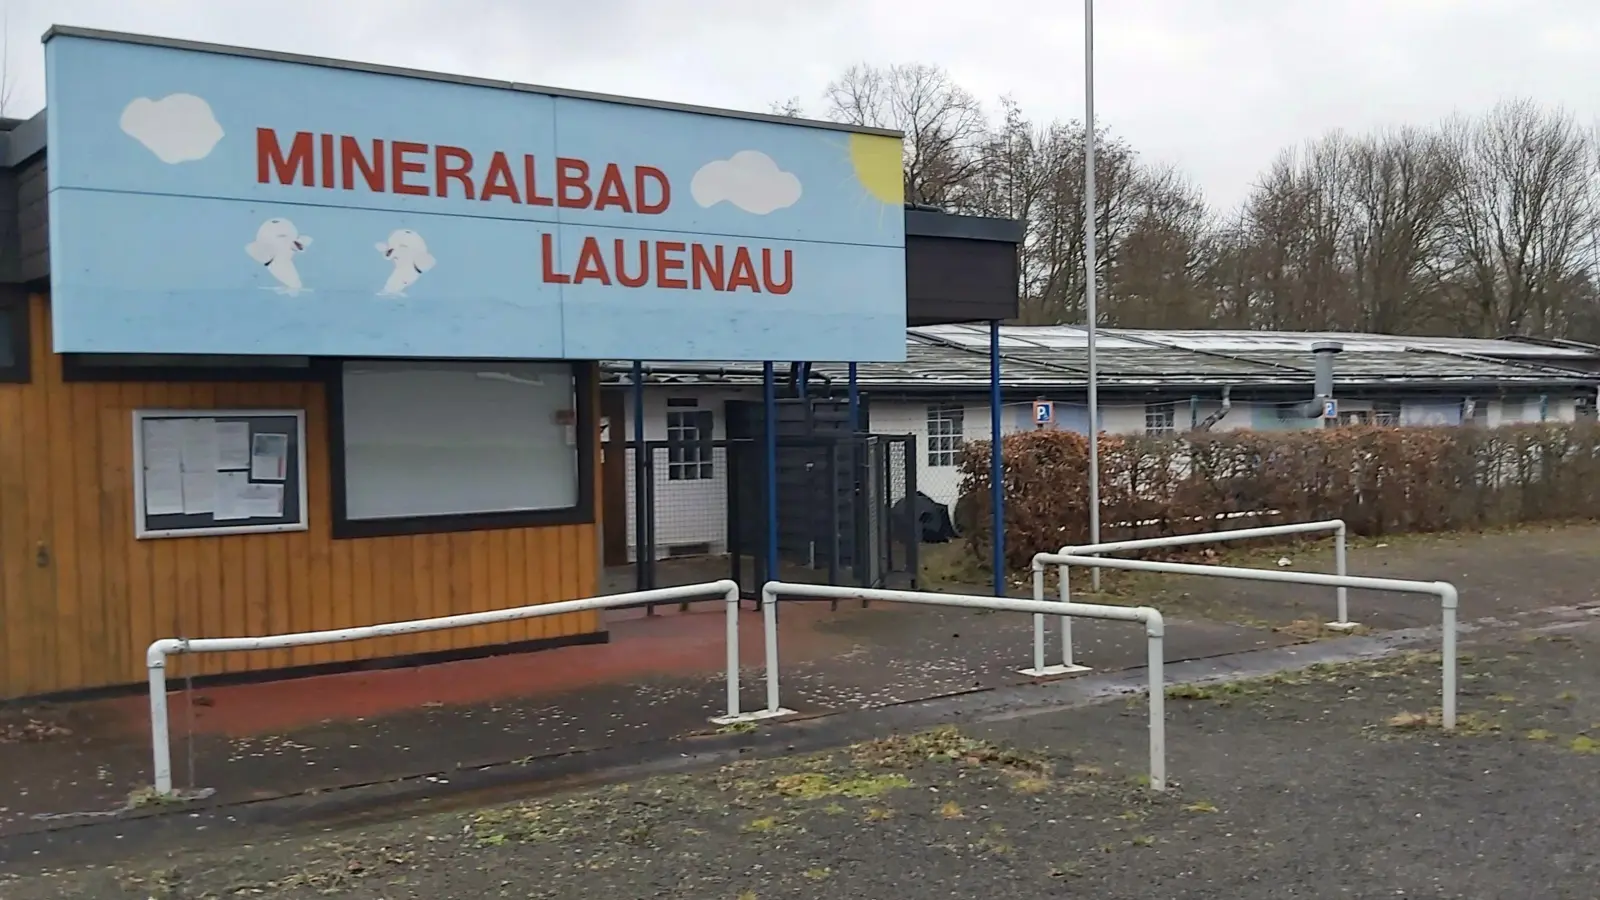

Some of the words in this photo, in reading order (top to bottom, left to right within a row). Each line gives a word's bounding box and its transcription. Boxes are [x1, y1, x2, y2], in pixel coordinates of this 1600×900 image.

[256, 127, 671, 215] MINERALBAD
[541, 234, 793, 296] LAUENAU
[1037, 406, 1046, 420] P
